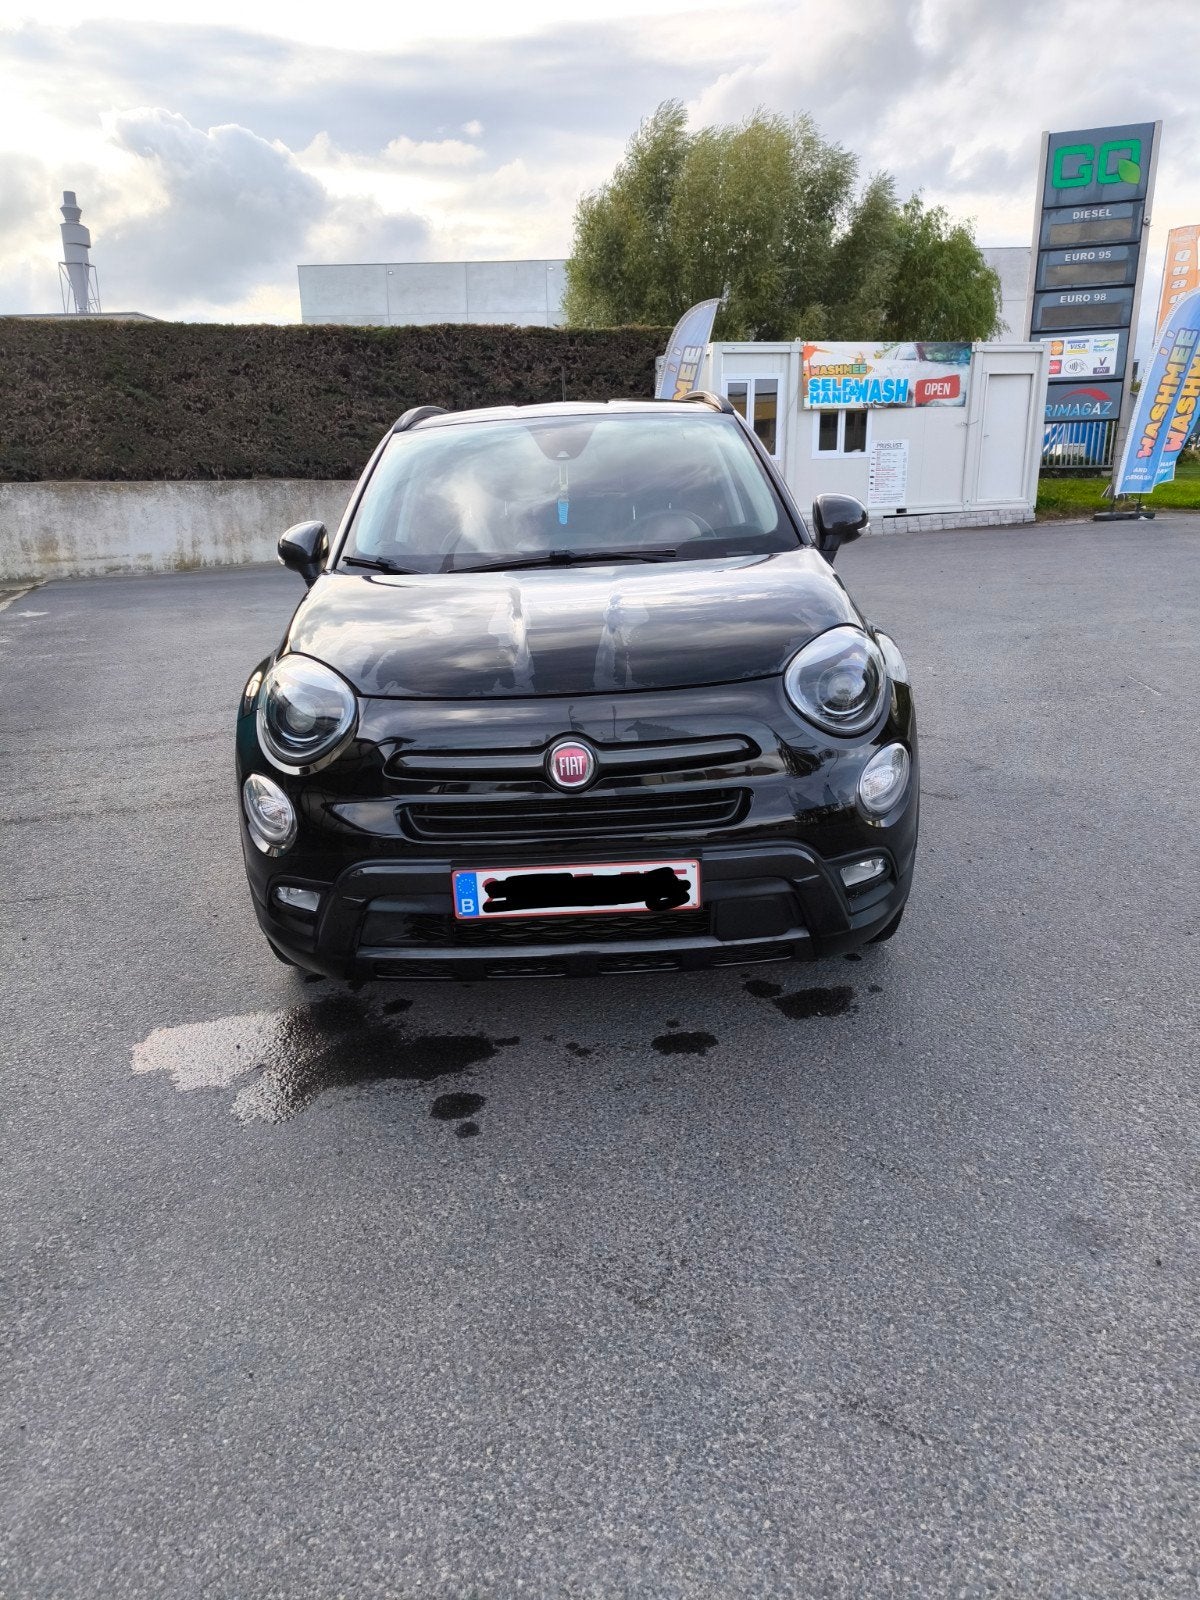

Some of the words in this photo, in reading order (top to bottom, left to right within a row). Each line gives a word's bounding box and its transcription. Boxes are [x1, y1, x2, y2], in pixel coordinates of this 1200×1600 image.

[1072, 208, 1113, 220] DIESEL
[1064, 251, 1095, 262] EURO
[1098, 250, 1112, 260] 95
[1060, 294, 1091, 304] EURO
[1093, 292, 1107, 302] 98
[810, 363, 867, 376] WASHMEE
[808, 377, 852, 393] SELF
[854, 377, 910, 403] WASH
[924, 382, 951, 396] OPEN
[1045, 402, 1113, 418] RIMAGAZ
[559, 755, 585, 776] FIAT
[461, 898, 475, 913] B
